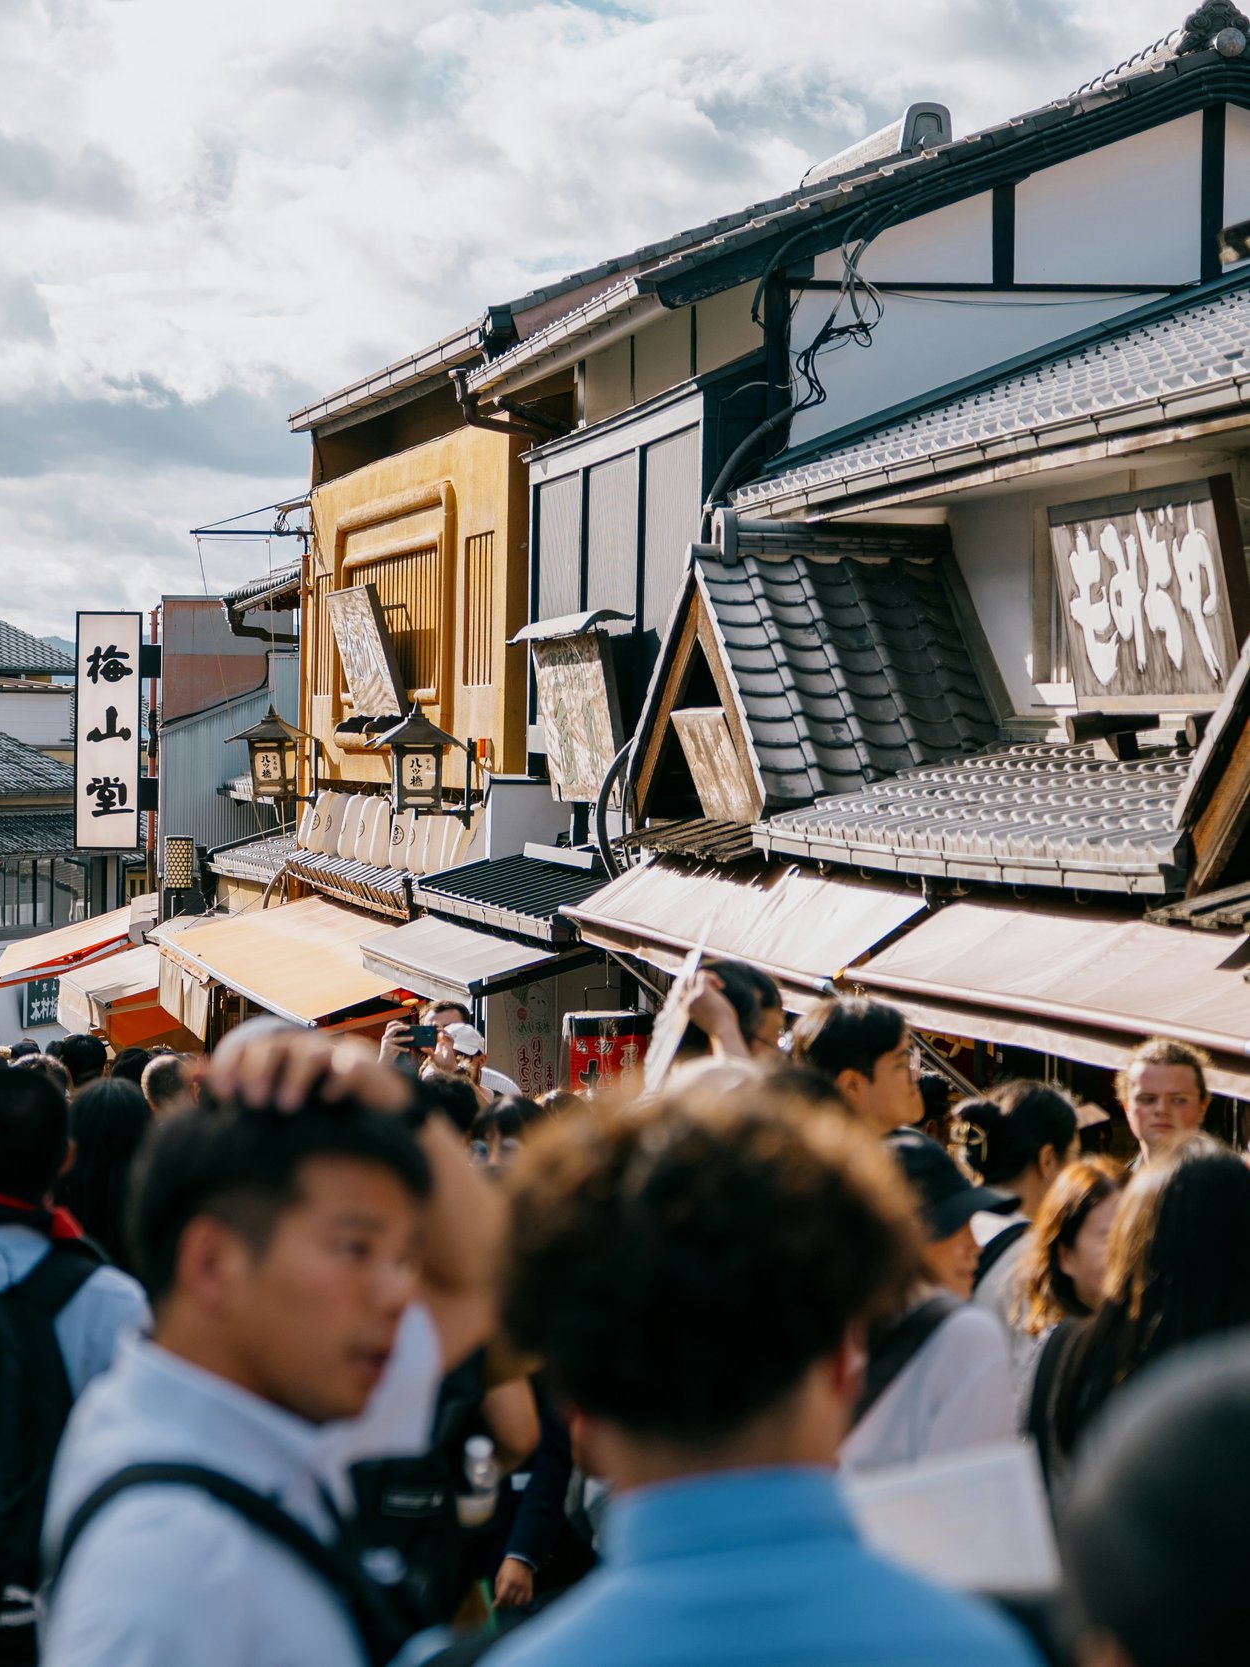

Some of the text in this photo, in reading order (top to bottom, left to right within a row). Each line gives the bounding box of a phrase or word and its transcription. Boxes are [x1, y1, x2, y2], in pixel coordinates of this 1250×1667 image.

[87, 645, 134, 817] 梅山堂
[261, 754, 272, 779] 八ツ橋
[410, 757, 423, 787] 八ツ橋
[576, 1039, 614, 1054] 名物
